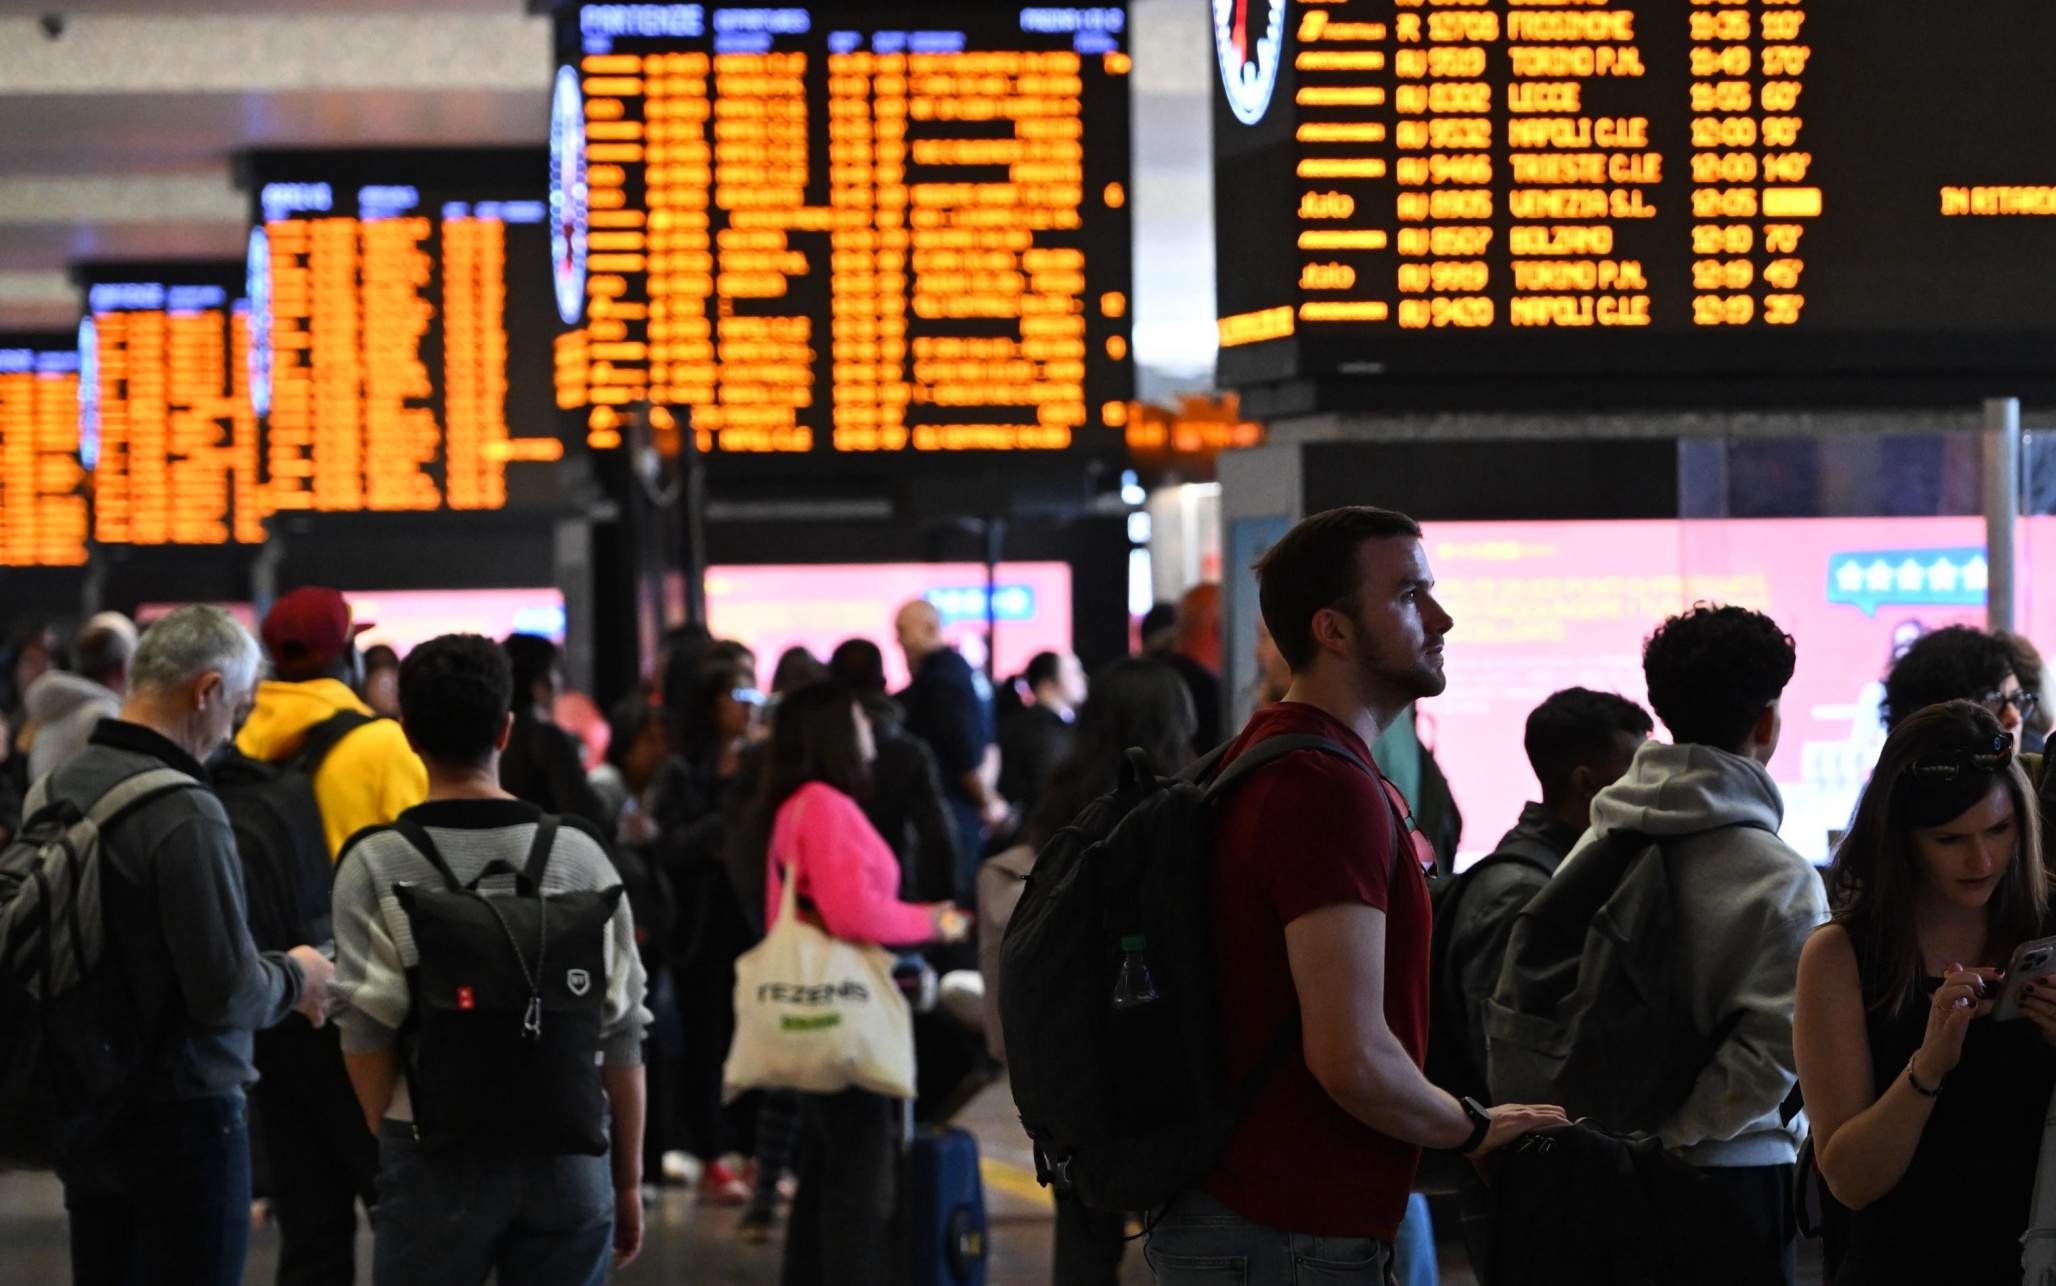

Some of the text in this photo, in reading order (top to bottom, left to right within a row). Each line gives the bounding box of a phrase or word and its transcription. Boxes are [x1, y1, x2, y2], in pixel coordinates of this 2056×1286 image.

[1508, 46, 1595, 76] TORINO
[1508, 82, 1582, 112] LECCE
[1509, 118, 1592, 148] NAPOLI
[1509, 153, 1607, 183] TRIESTE
[1509, 189, 1608, 219] VENEZIA
[1510, 226, 1614, 255] BOLZANO
[1511, 261, 1596, 291] TORINO
[1511, 296, 1595, 326] NAPOLI
